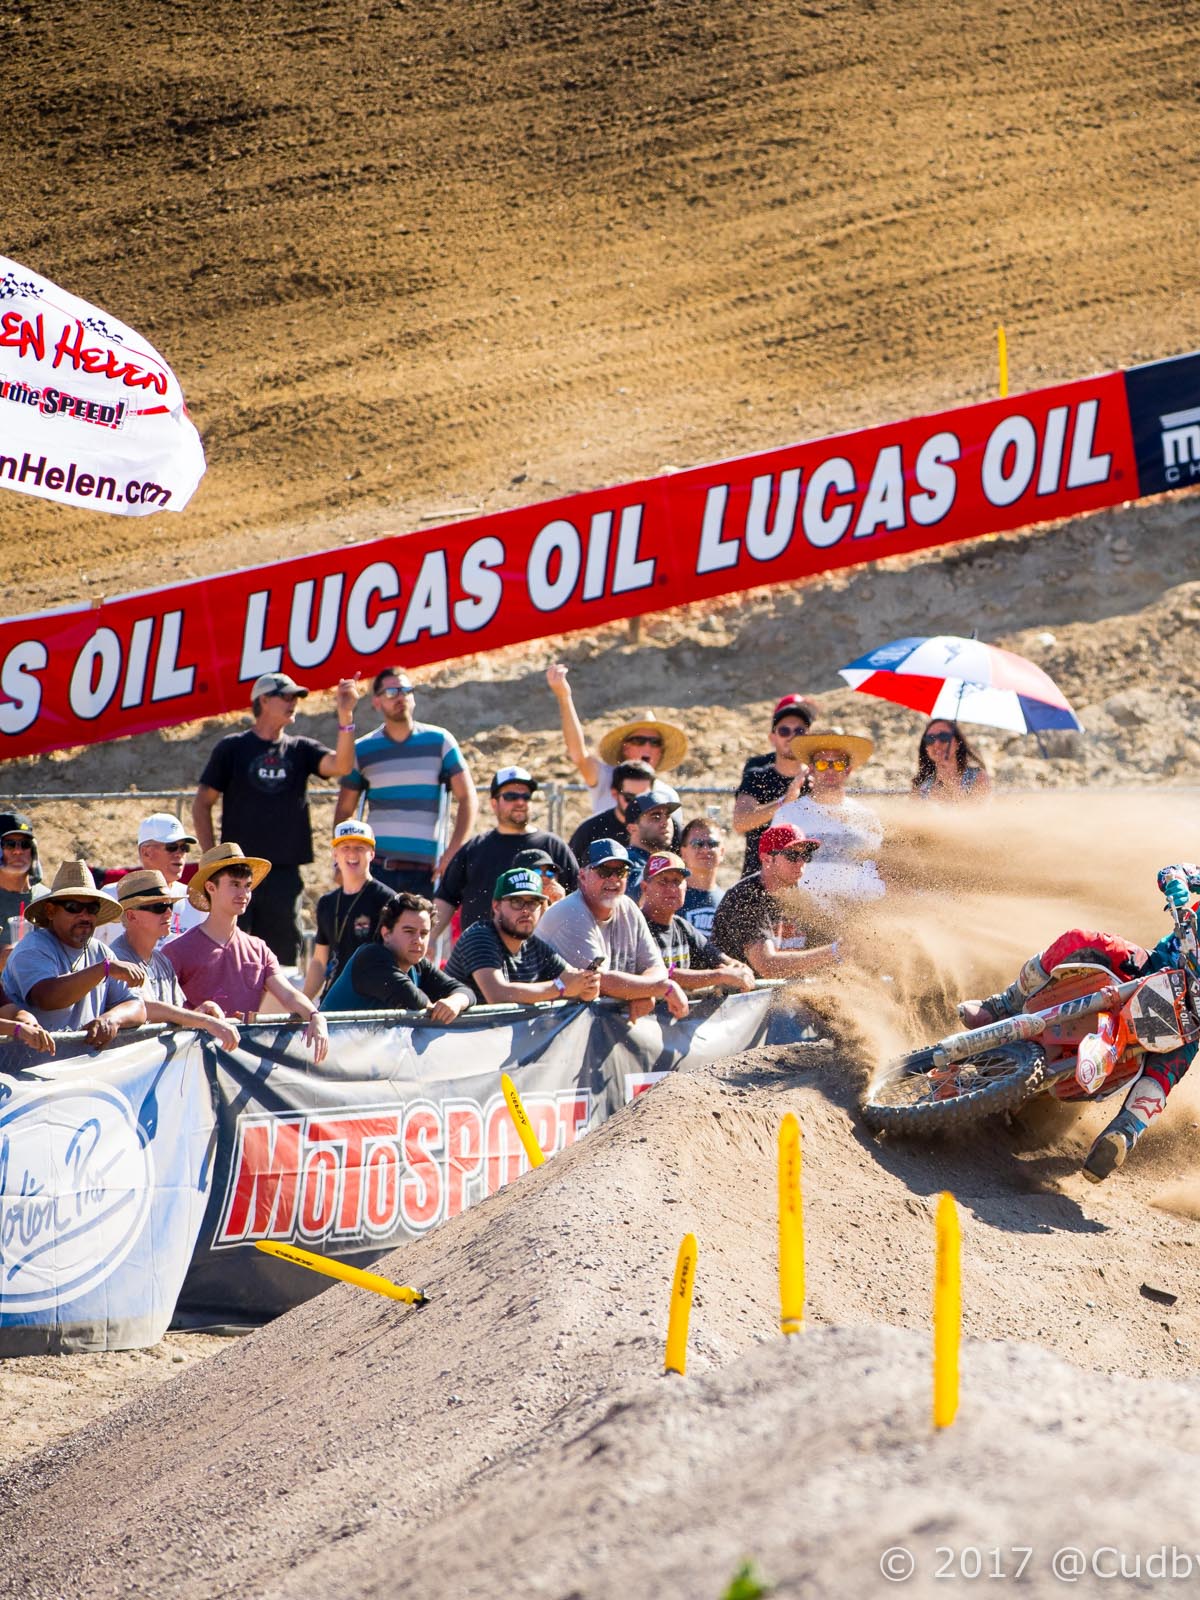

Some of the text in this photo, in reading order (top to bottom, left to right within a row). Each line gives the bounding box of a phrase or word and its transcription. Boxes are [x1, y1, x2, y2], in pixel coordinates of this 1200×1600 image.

[43, 388, 125, 426] SPEED!
[696, 399, 1111, 575] LUCAS OIL
[239, 503, 656, 683] LUCAS OIL
[69, 610, 196, 719] OIL
[1136, 984, 1180, 1044] 4
[0, 1134, 71, 1248] otion
